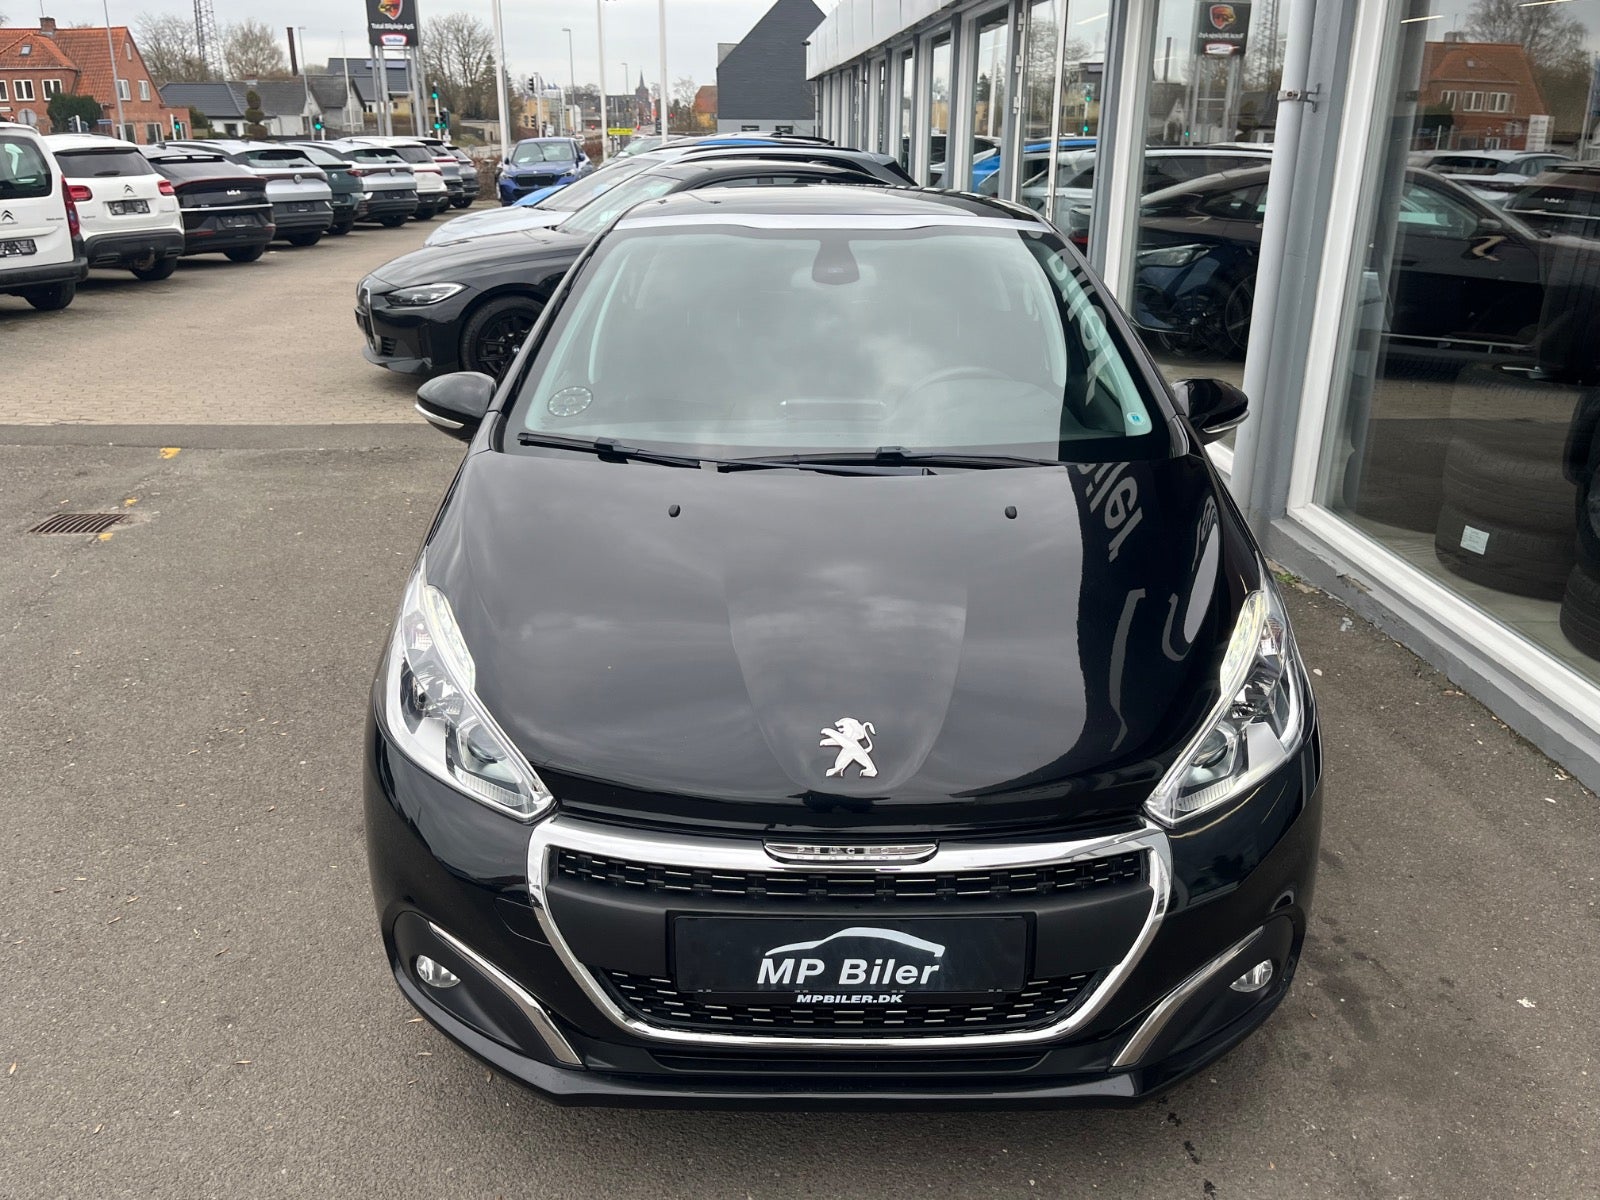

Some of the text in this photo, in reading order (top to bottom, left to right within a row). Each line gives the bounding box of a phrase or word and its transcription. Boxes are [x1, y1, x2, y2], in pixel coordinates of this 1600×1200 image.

[757, 959, 940, 985] MP Biler
[796, 994, 904, 1004] MPBILER.DK
